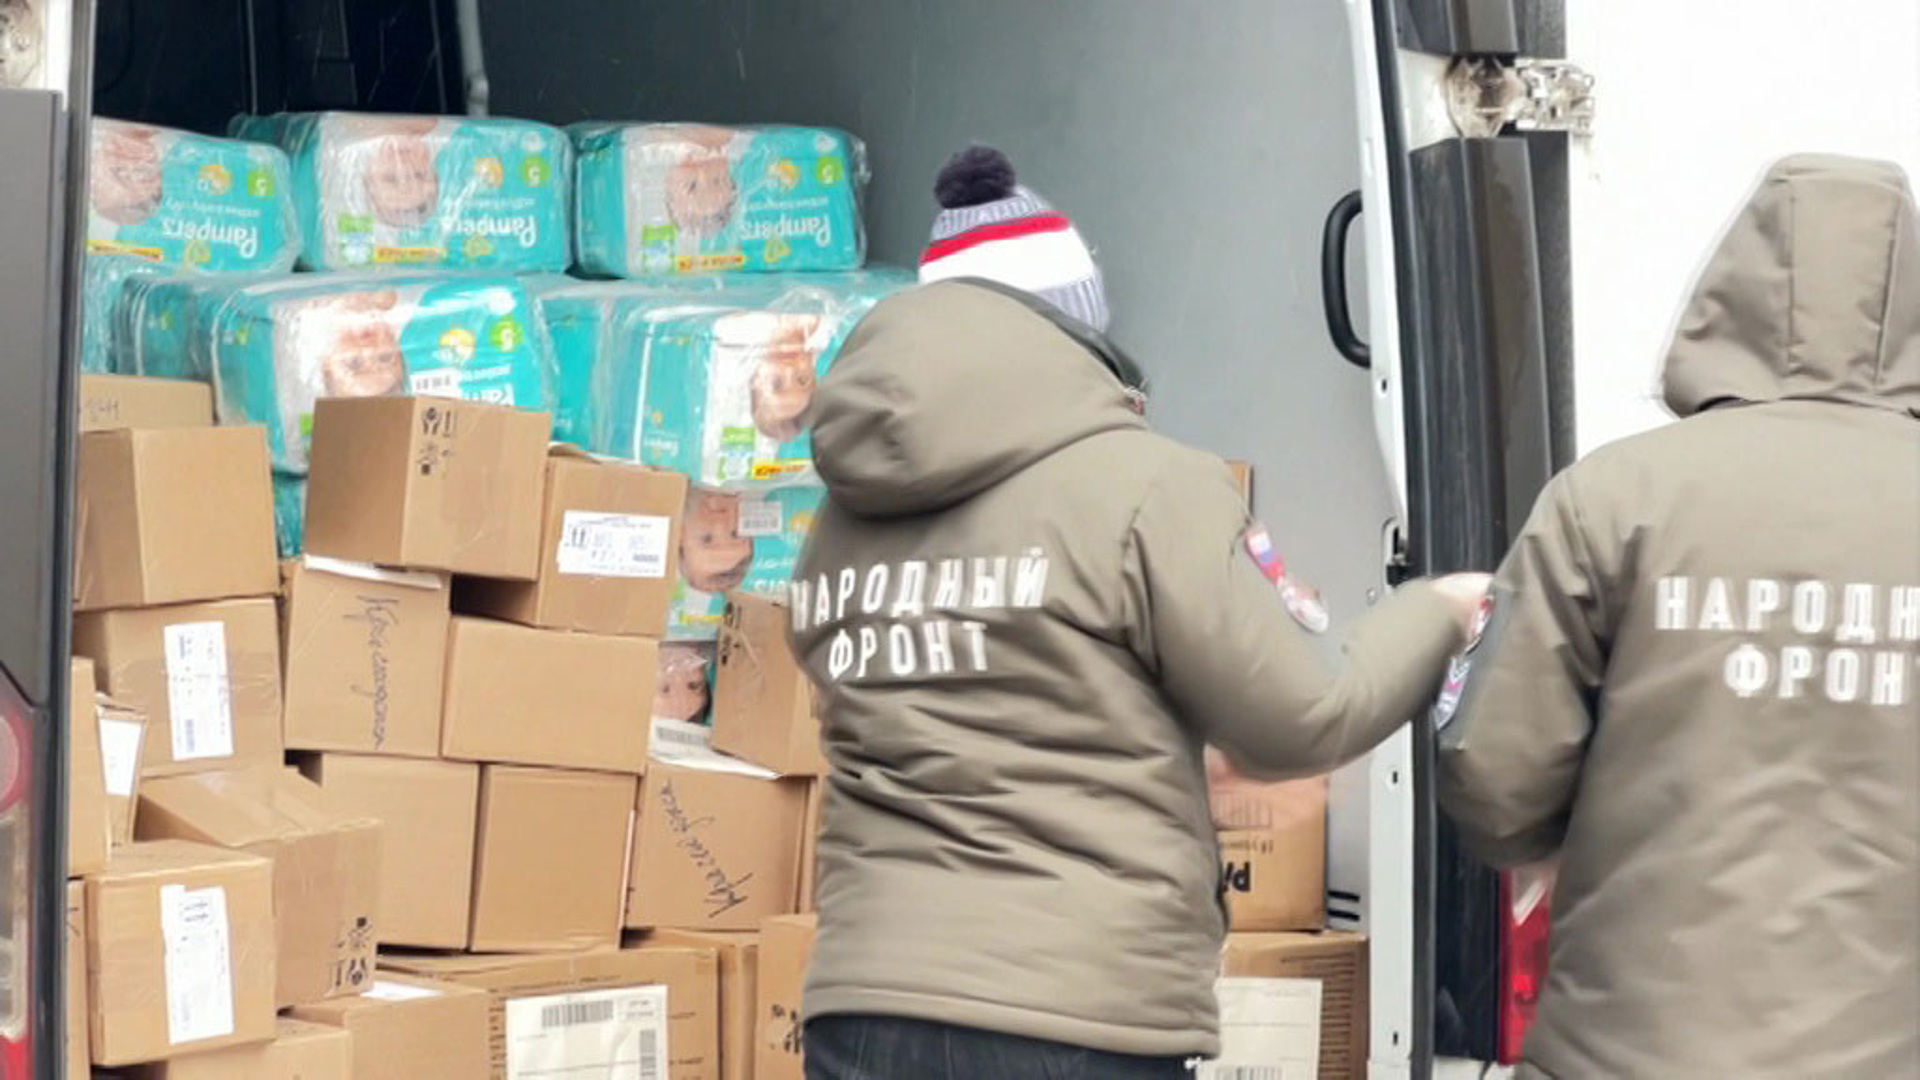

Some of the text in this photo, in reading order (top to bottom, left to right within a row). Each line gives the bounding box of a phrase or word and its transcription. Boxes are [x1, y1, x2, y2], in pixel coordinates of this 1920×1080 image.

[160, 216, 260, 260] Pampers
[738, 212, 832, 248] Pampers
[791, 547, 1049, 631] НАРОДНЫЙ
[1655, 576, 1920, 645] НАРОДН
[828, 620, 988, 680] ФРОНТ
[1723, 643, 1920, 706] ФРОН
